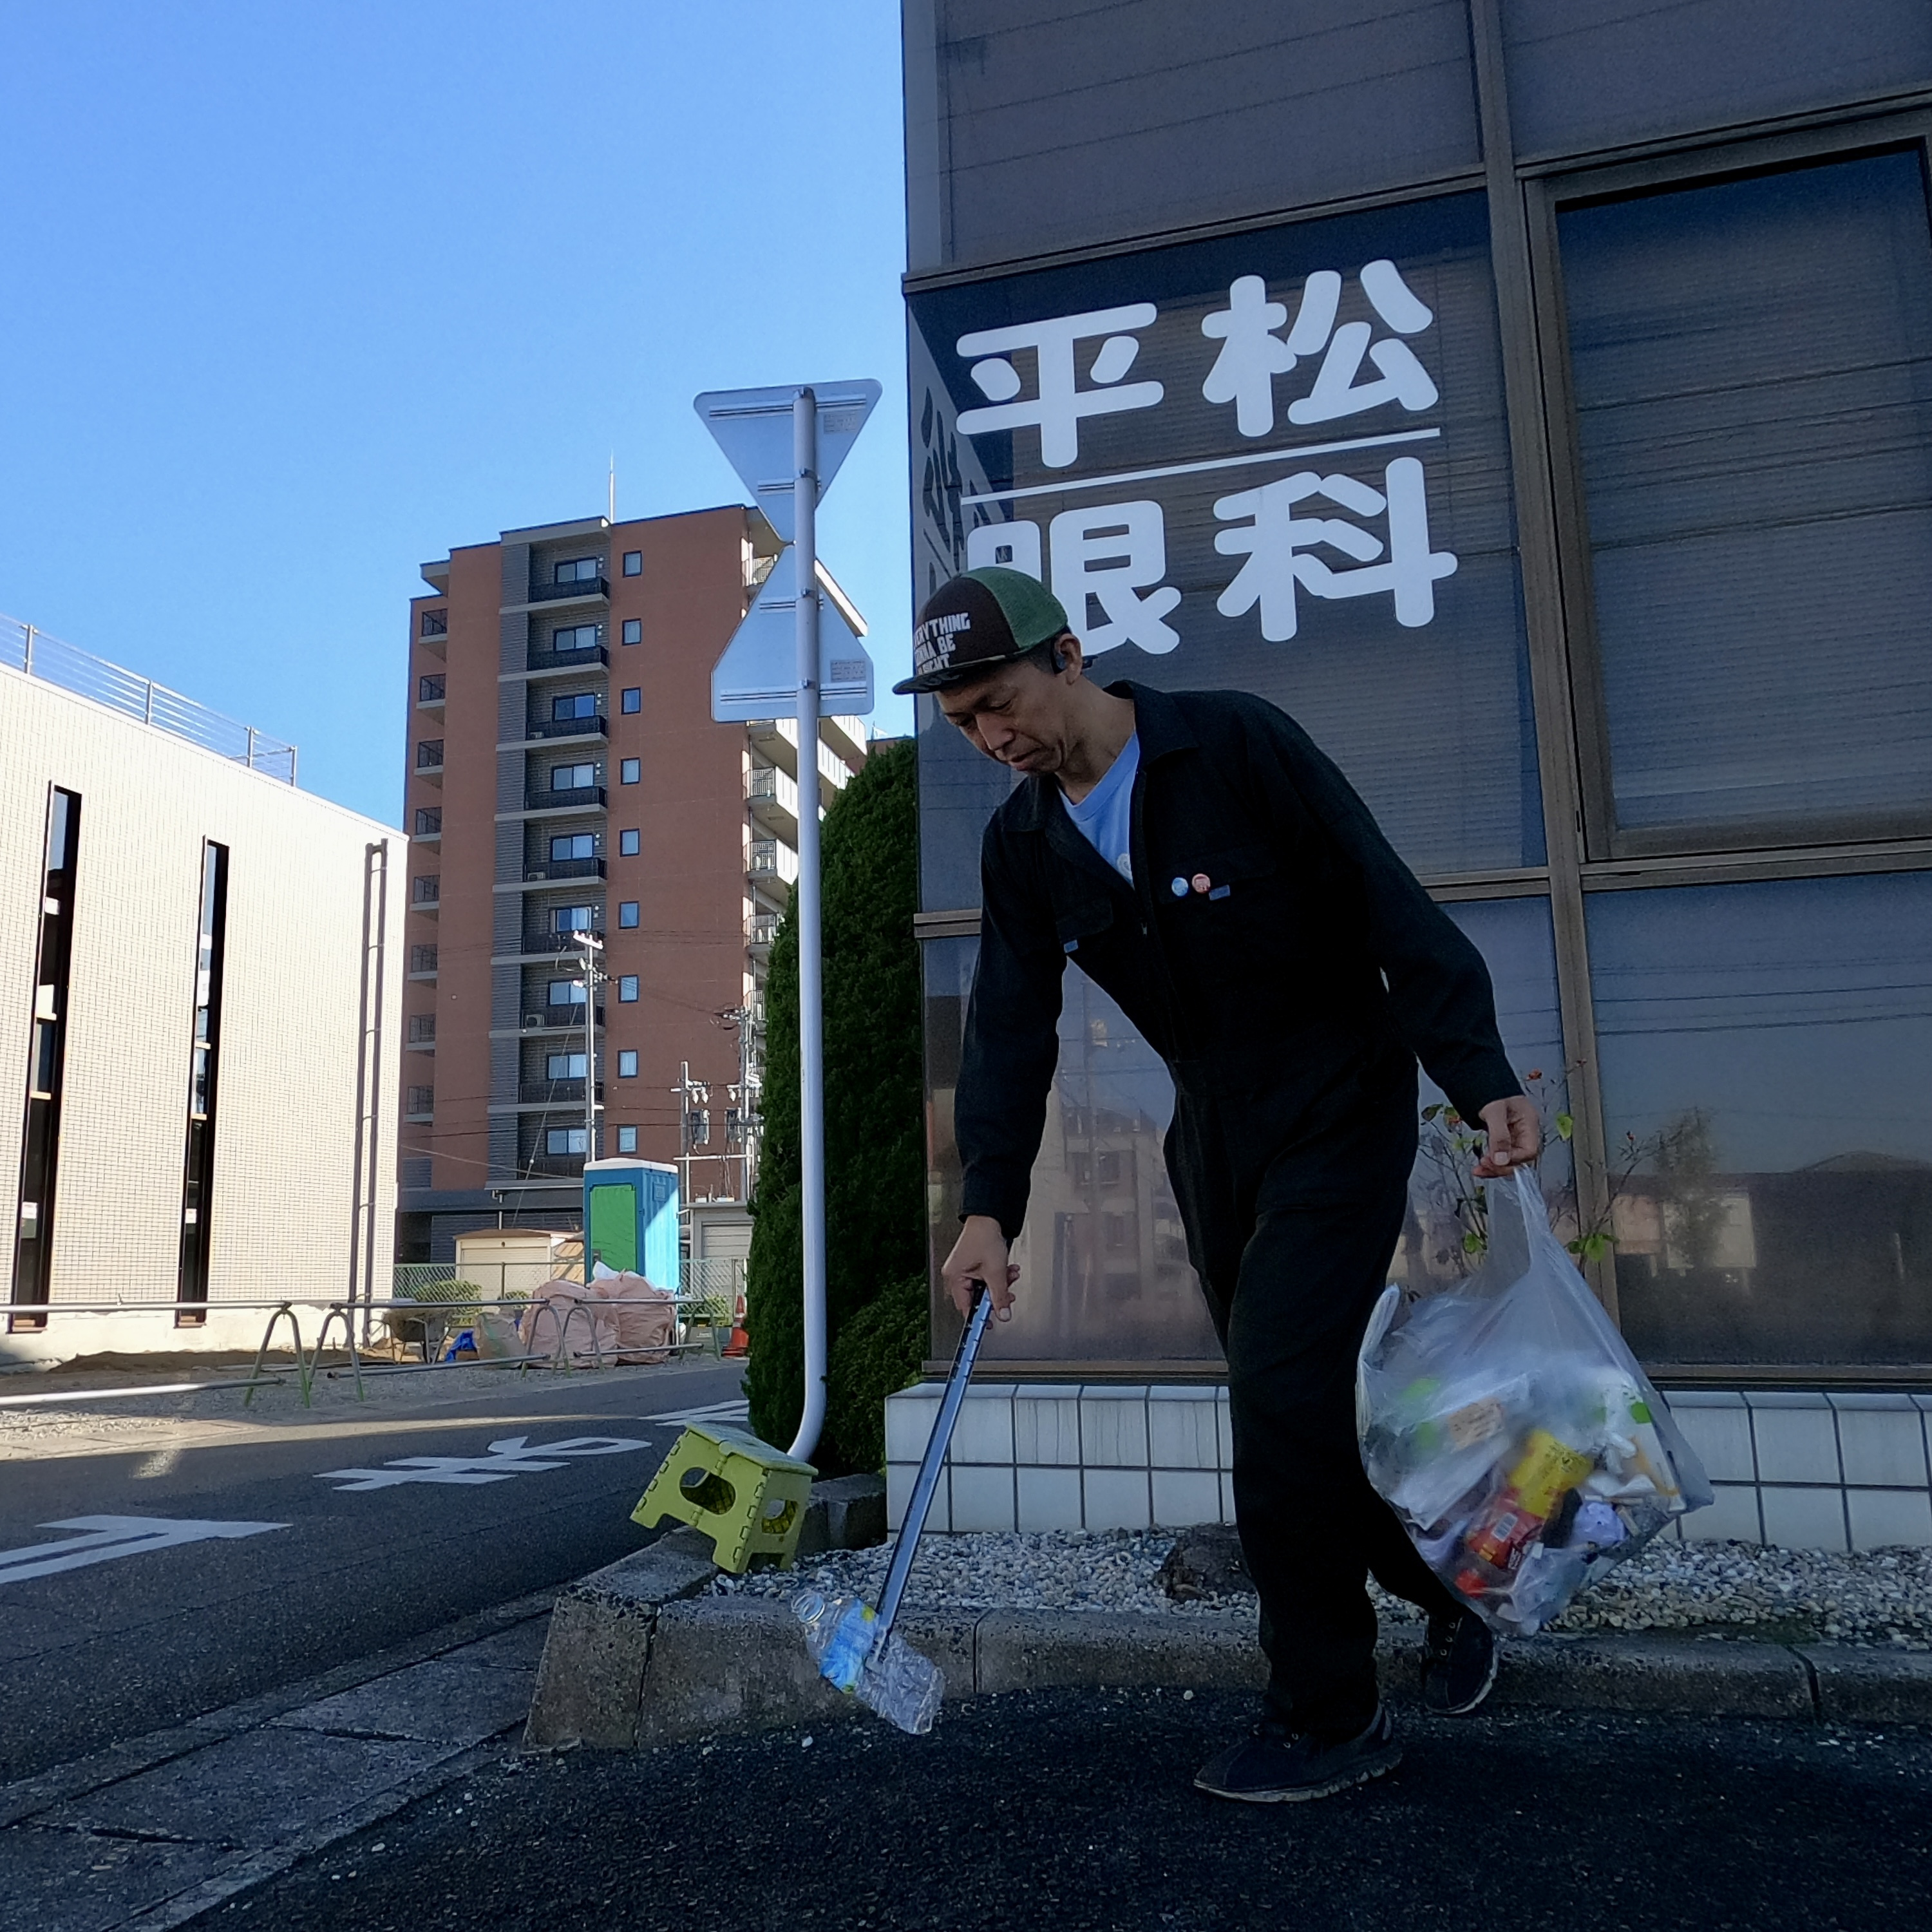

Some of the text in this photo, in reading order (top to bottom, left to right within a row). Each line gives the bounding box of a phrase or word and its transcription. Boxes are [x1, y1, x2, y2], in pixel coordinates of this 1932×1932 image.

[956, 260, 1439, 469] 平松
[936, 633, 956, 655] BE
[967, 457, 1458, 656] 眼科
